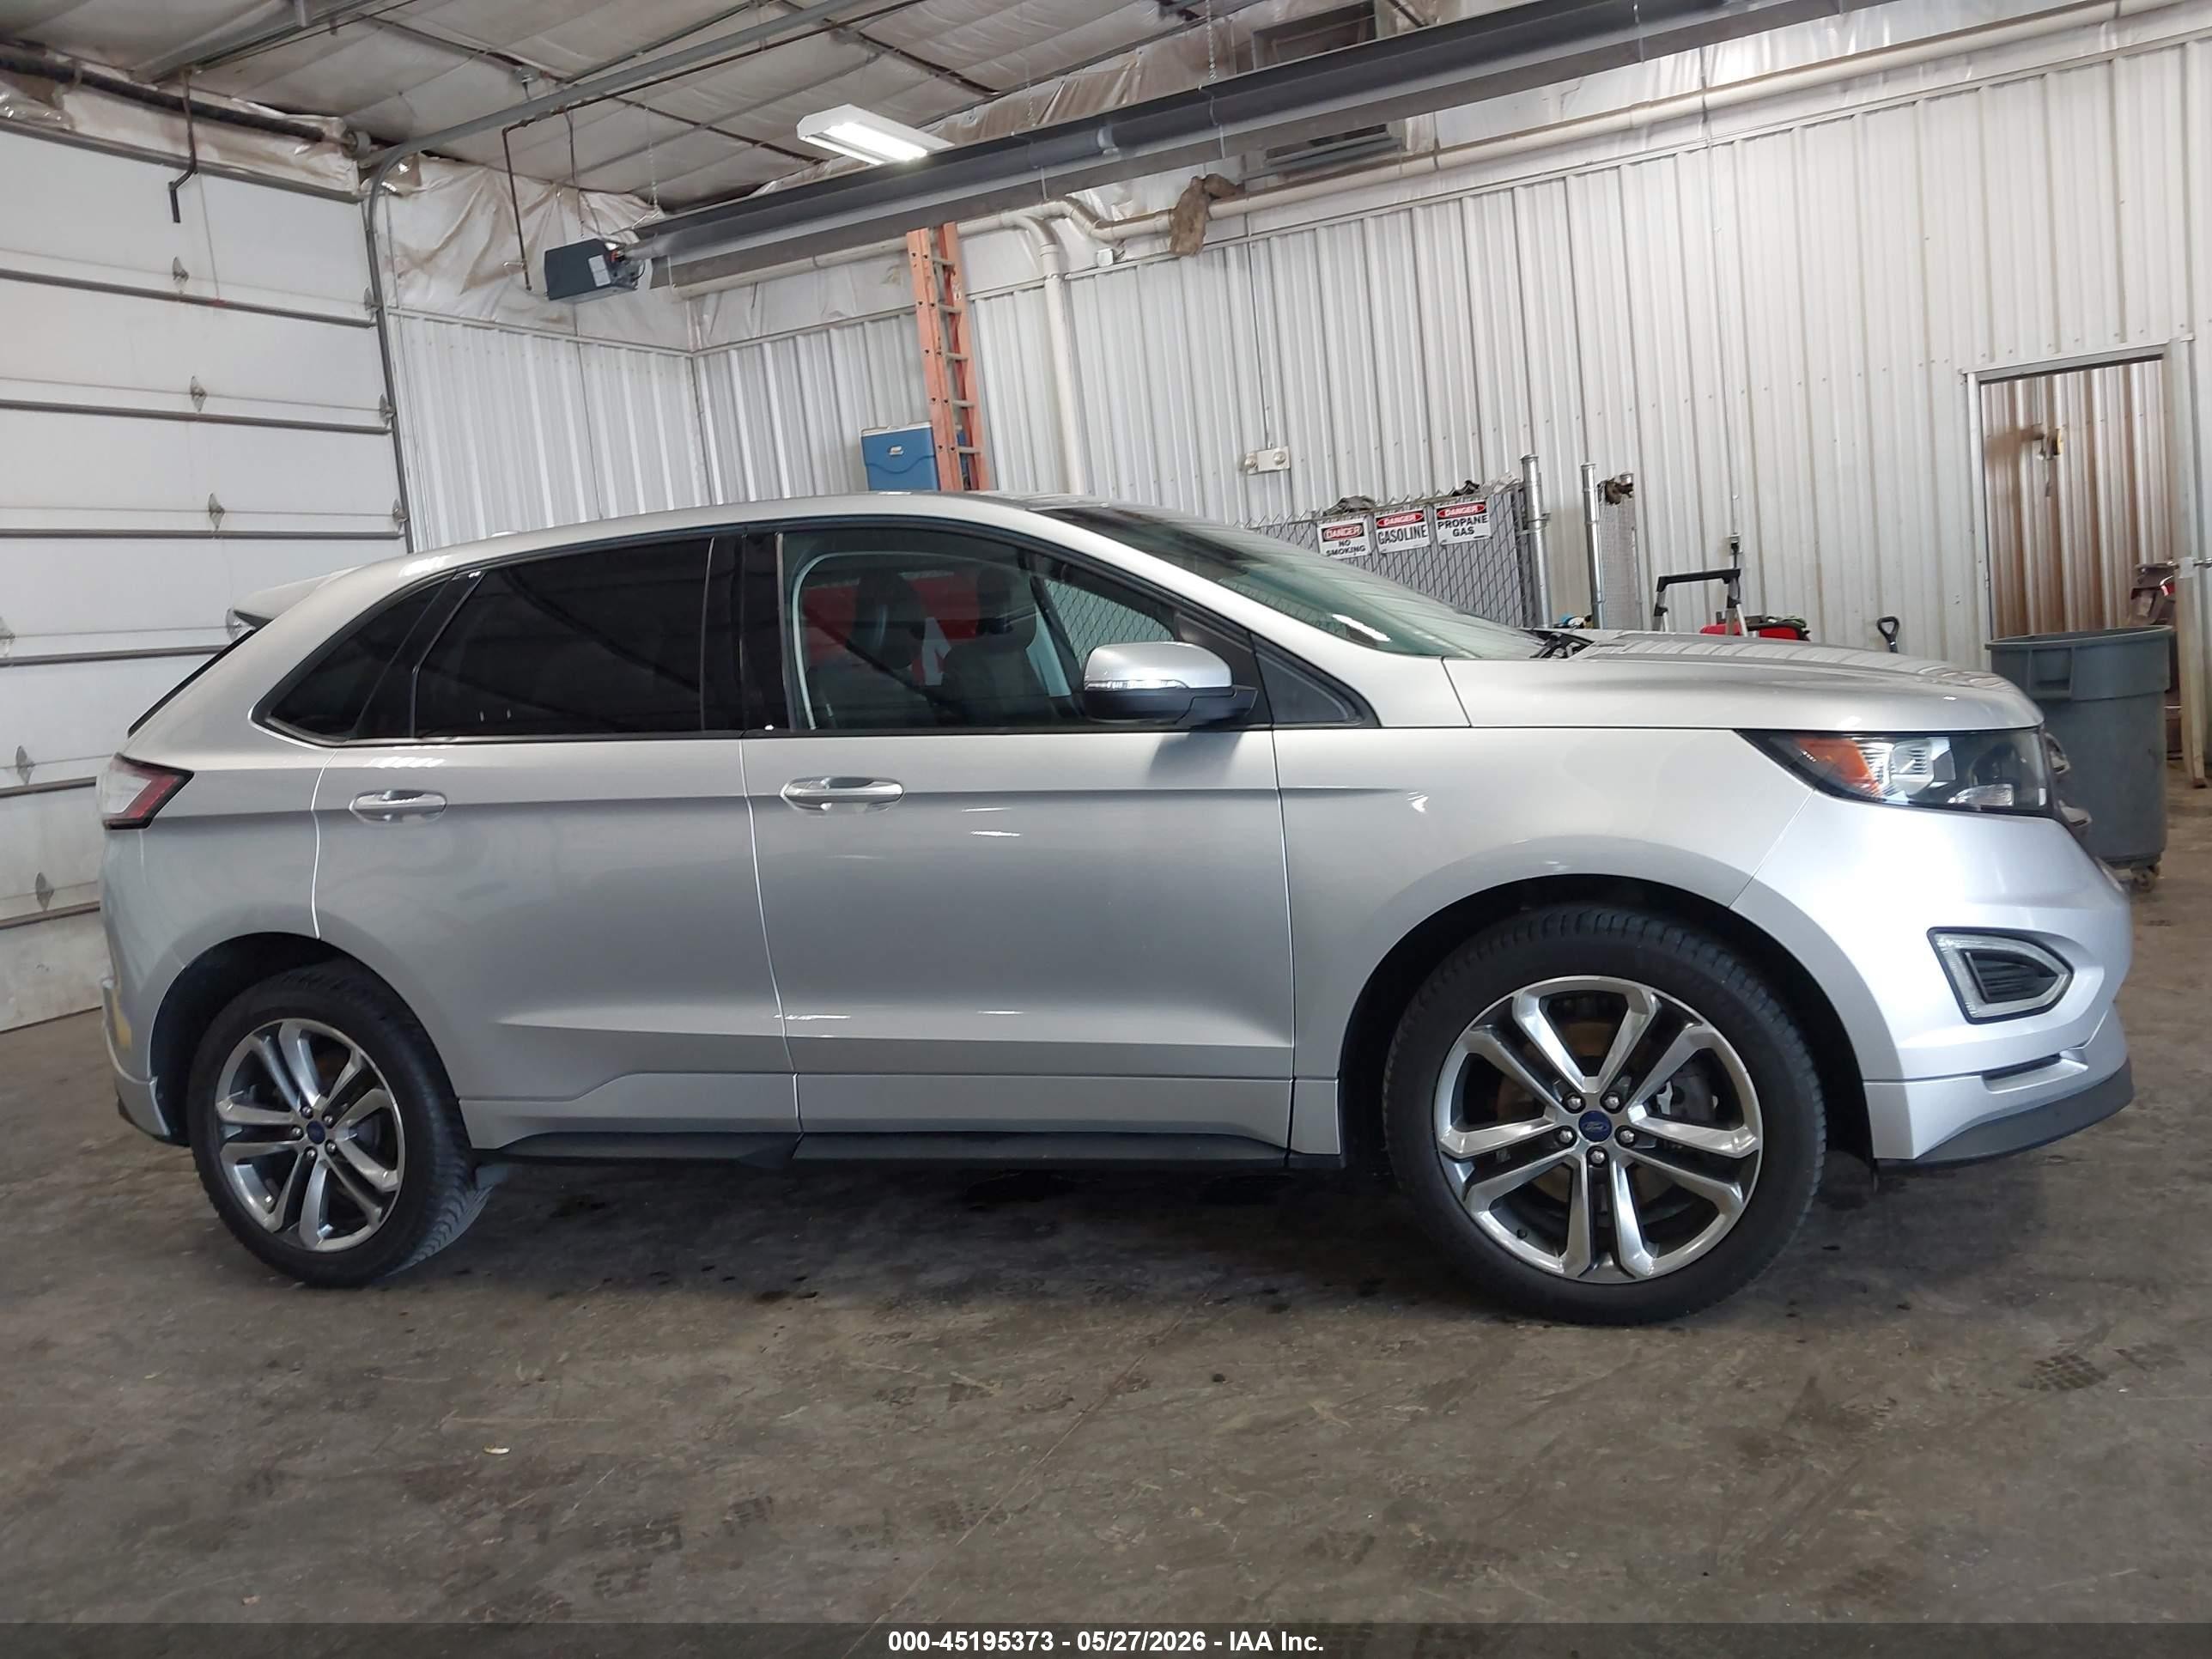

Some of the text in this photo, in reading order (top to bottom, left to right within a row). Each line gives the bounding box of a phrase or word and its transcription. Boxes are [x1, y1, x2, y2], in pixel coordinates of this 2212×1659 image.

[1444, 506, 1479, 516] DANGER
[1383, 514, 1417, 526] DANGER
[1437, 515, 1489, 530] PROPANE
[1324, 525, 1362, 538] DANGER
[1377, 525, 1429, 544] GASOLINE
[1452, 526, 1475, 538] GAS
[1339, 539, 1352, 548] NO
[1326, 544, 1366, 556] SMOKING
